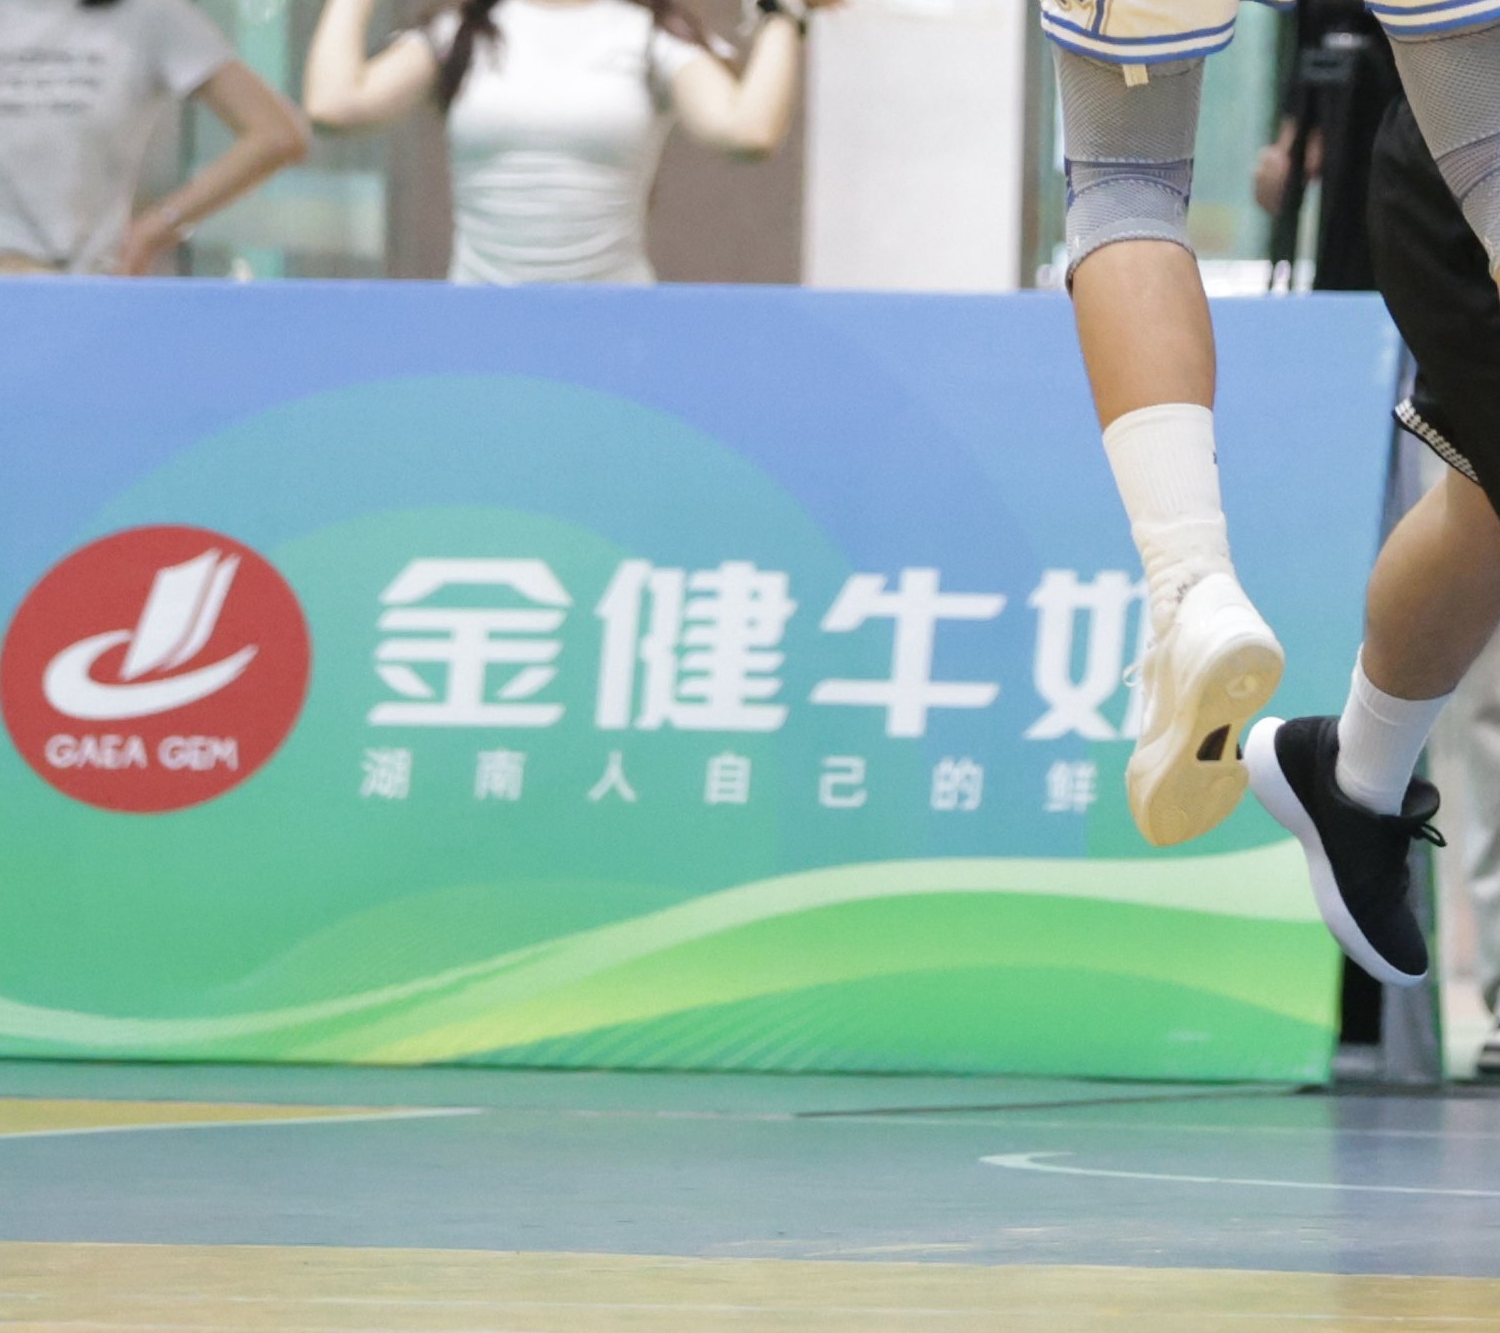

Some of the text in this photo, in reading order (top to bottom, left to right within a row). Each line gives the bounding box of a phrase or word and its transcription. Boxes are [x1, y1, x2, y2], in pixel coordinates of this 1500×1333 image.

[44, 733, 239, 771] GAEA GEM
[359, 748, 1097, 812] 湖南人自己的鲜
